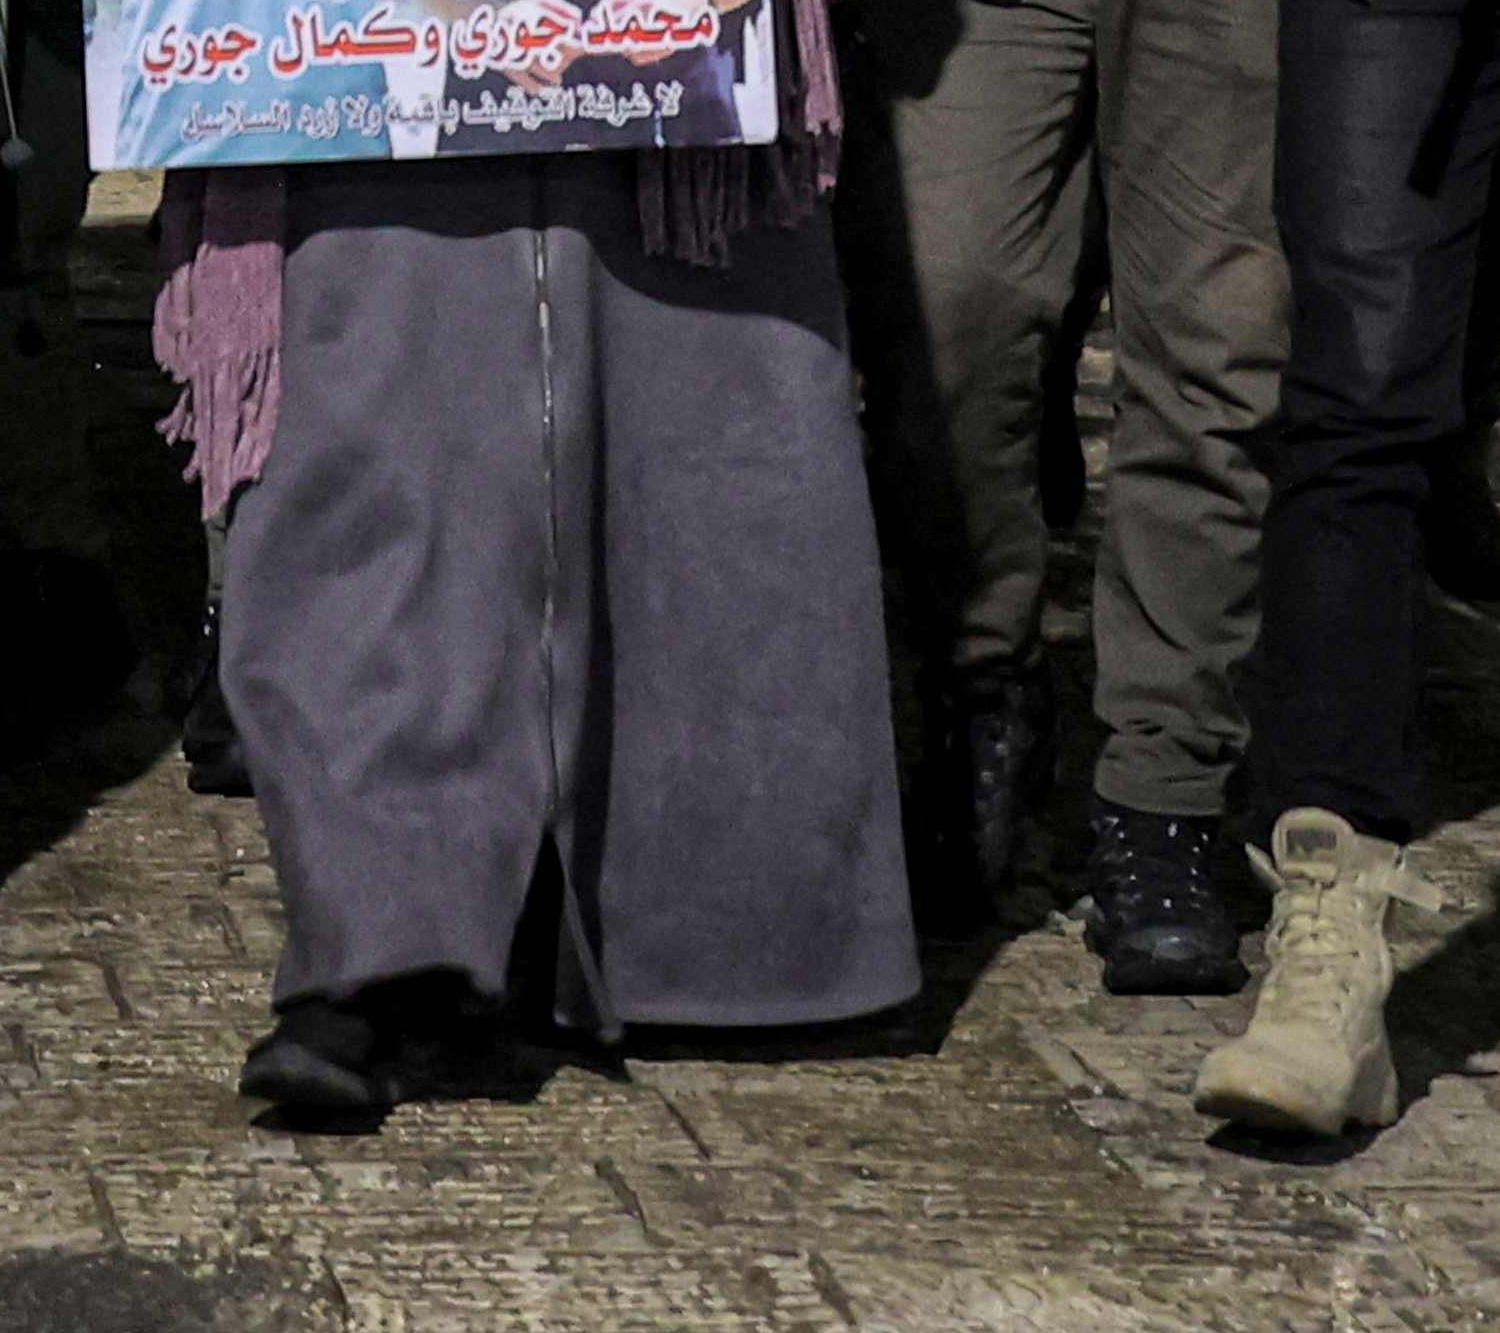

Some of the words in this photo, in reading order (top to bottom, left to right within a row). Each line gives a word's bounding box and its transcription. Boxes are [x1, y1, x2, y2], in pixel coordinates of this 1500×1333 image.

[273, 6, 444, 73] وكمال
[453, 9, 570, 71] جوري
[582, 4, 717, 48] محمد
[142, 23, 259, 84] جوري
[578, 83, 653, 127] غرفة
[654, 79, 686, 119] لا
